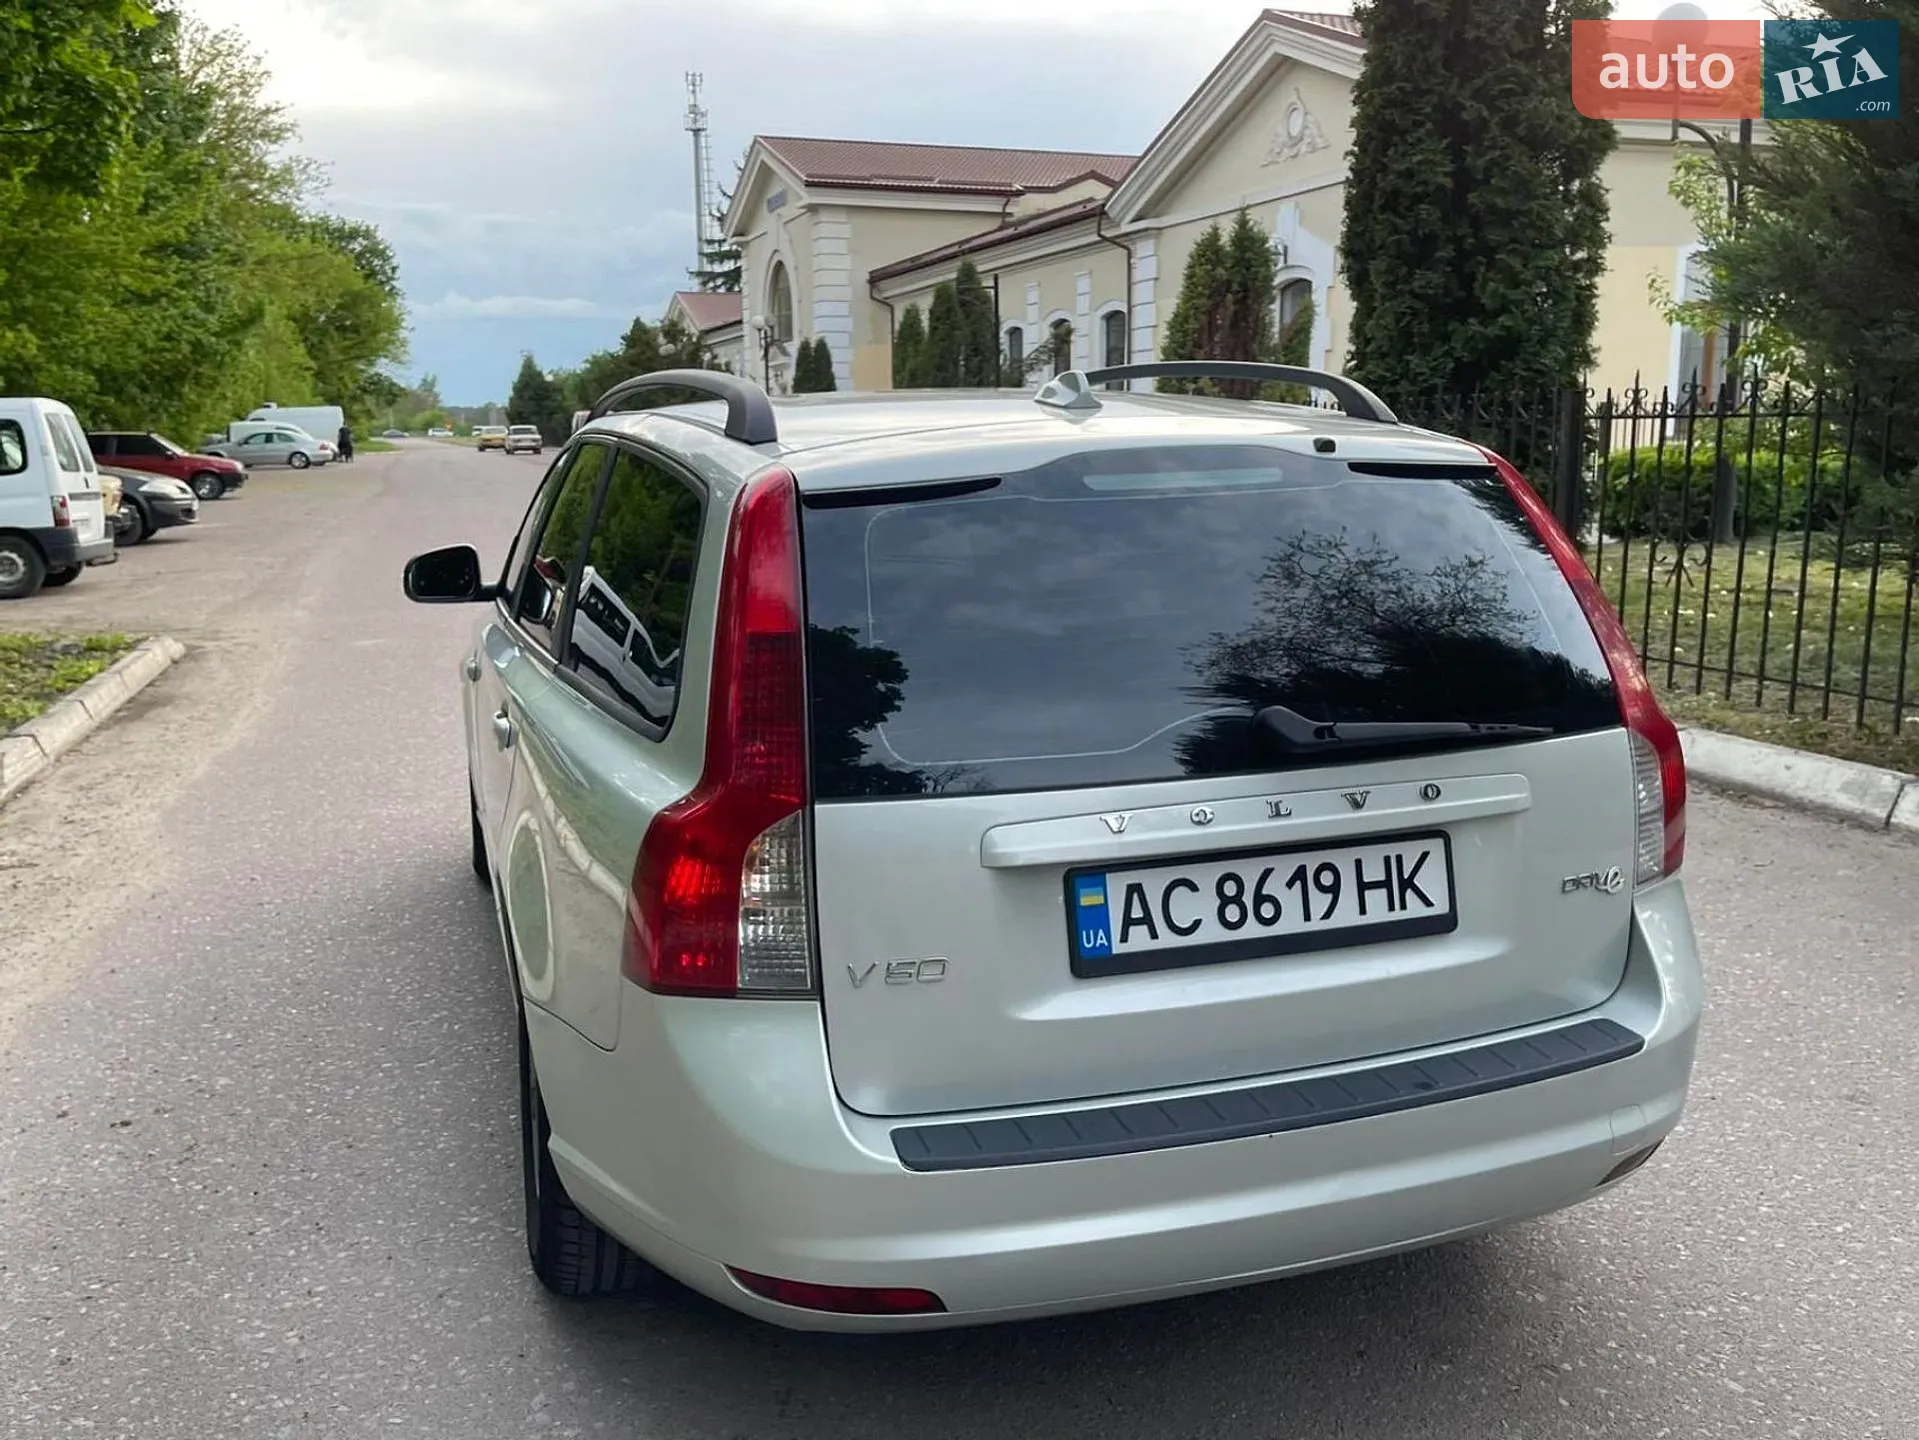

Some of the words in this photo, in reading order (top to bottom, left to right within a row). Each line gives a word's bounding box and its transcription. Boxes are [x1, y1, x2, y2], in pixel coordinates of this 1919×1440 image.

[1100, 783, 1441, 834] VOLVO
[1119, 877, 1202, 944] AC
[1215, 861, 1342, 931] 8619
[1354, 850, 1435, 916] HK
[1082, 929, 1108, 948] UA
